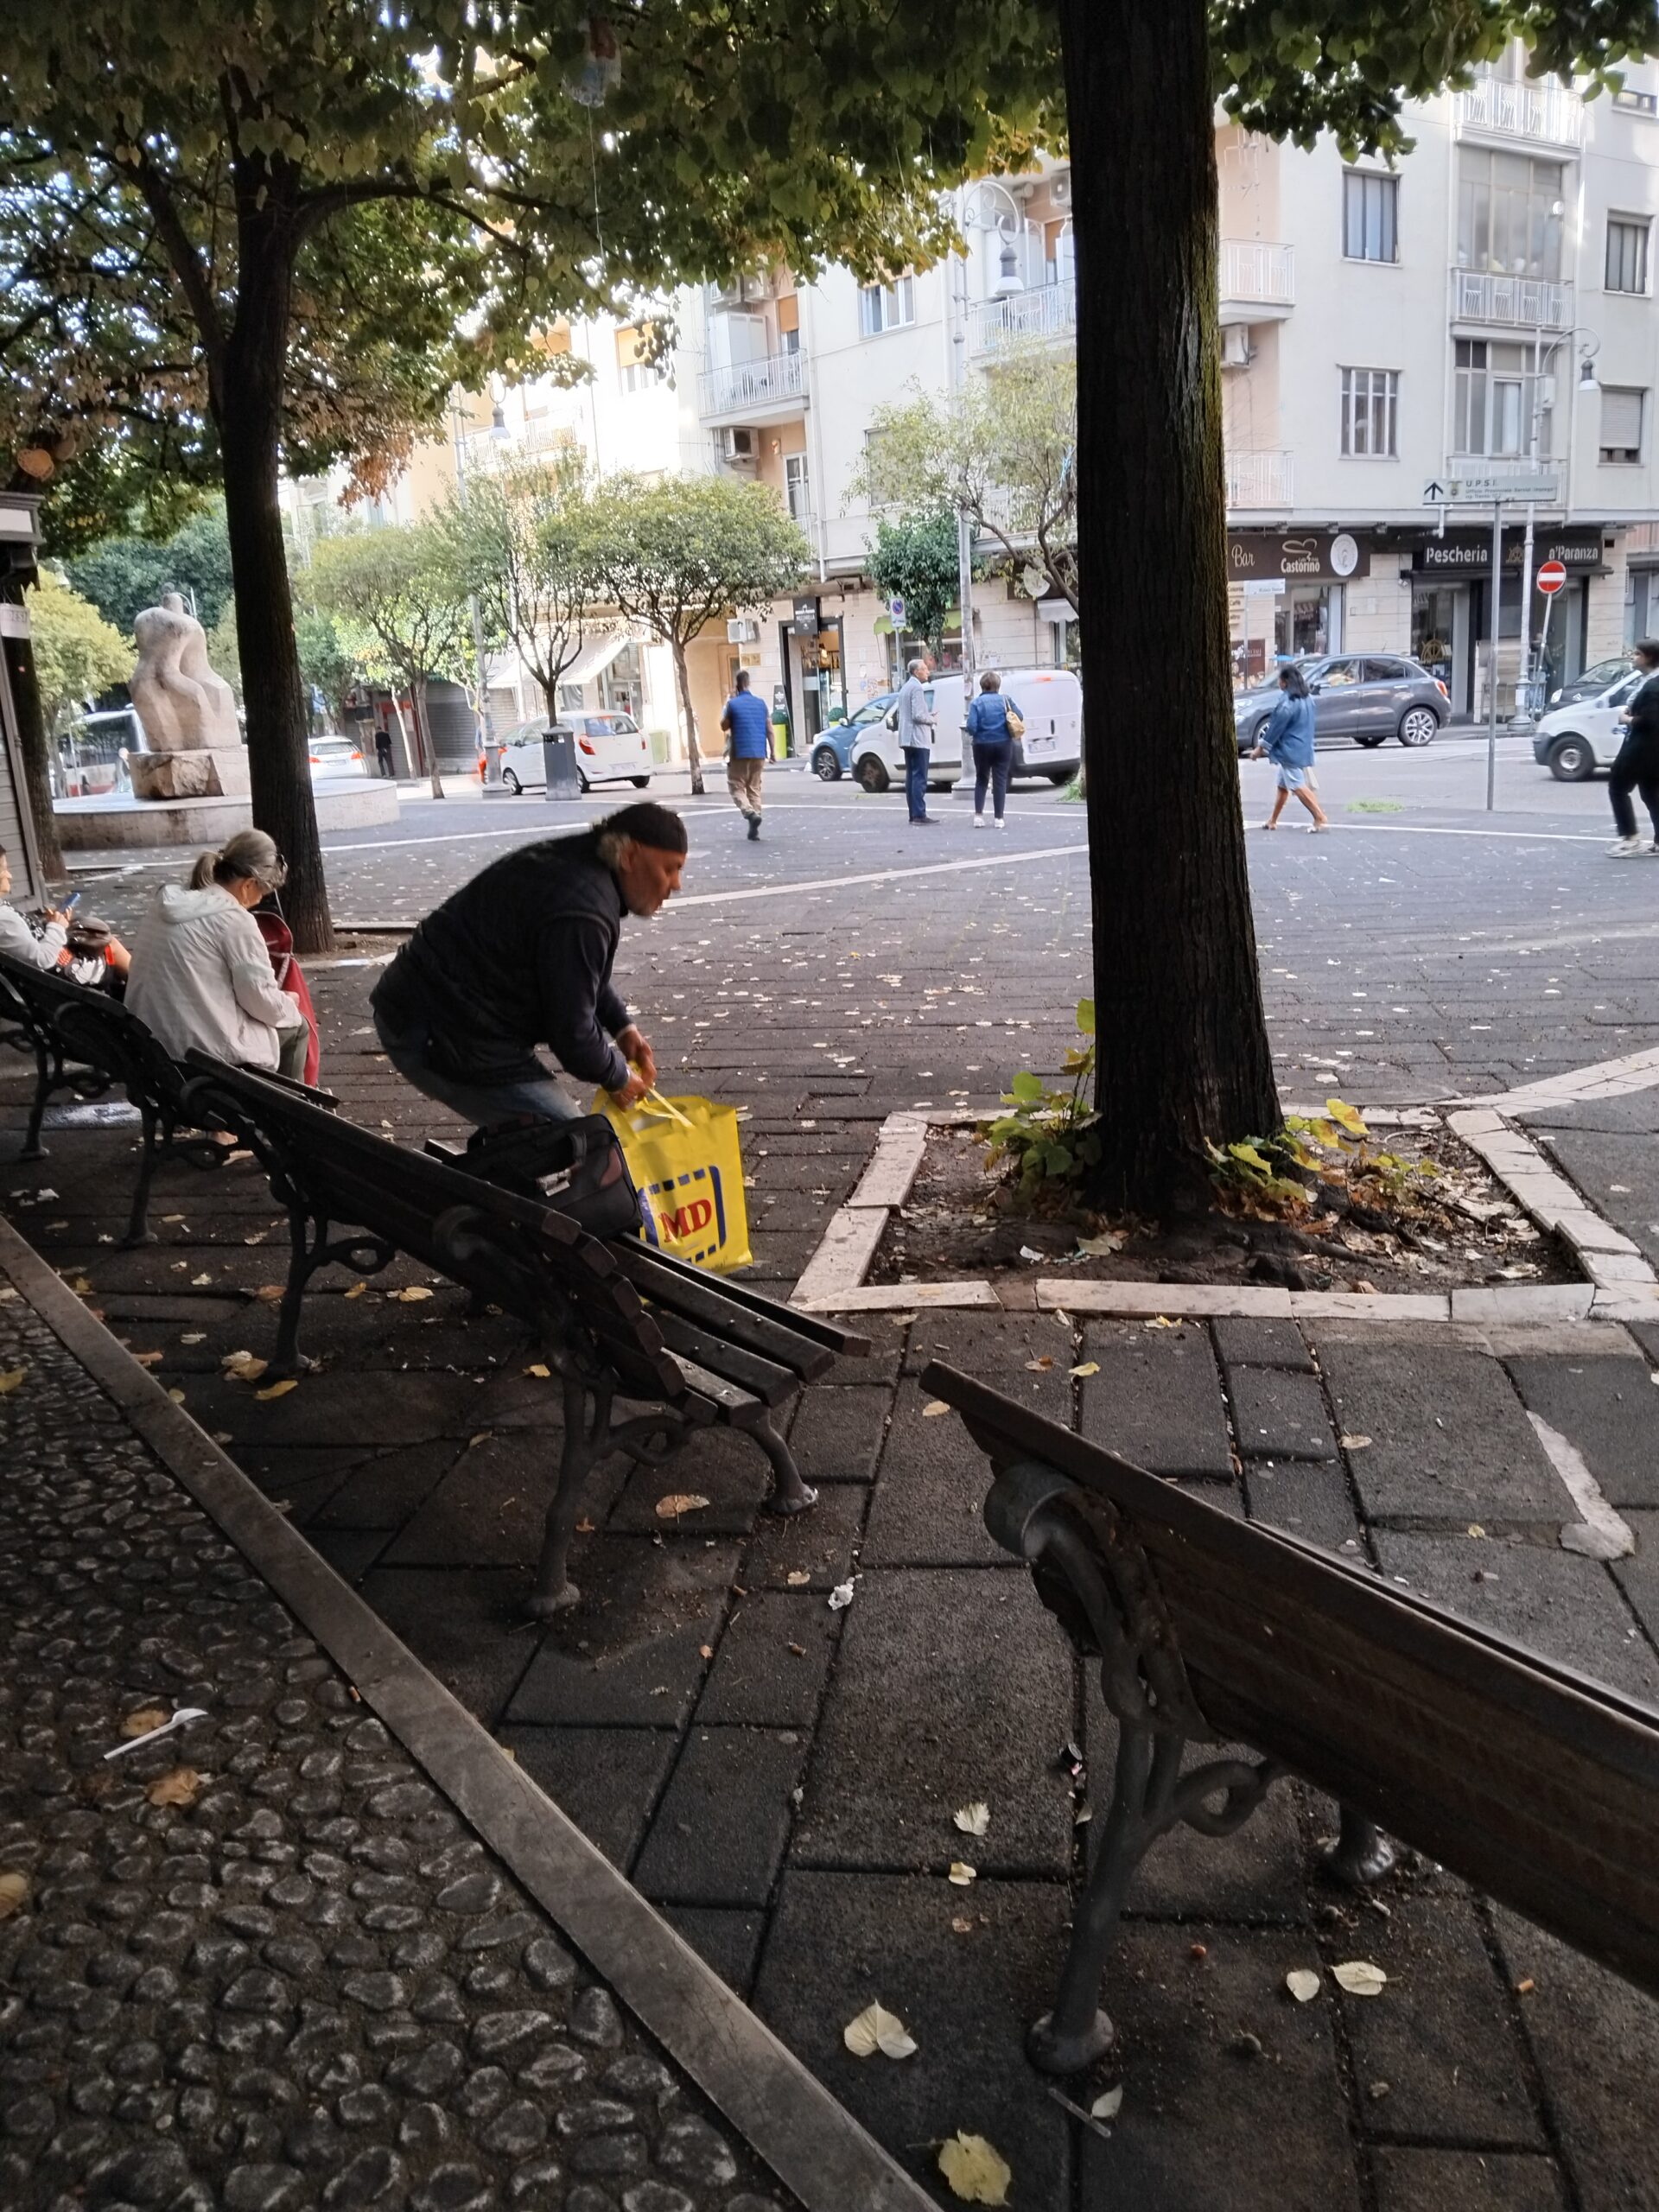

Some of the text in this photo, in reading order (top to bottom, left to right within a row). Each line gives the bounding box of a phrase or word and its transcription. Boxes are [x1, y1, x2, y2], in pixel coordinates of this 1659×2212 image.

[1231, 543, 1255, 568] Bar
[1426, 544, 1488, 563] Pescheria
[1548, 545, 1599, 561] a'Paranza
[1281, 557, 1320, 574] Castorino
[658, 1198, 712, 1243] MD
